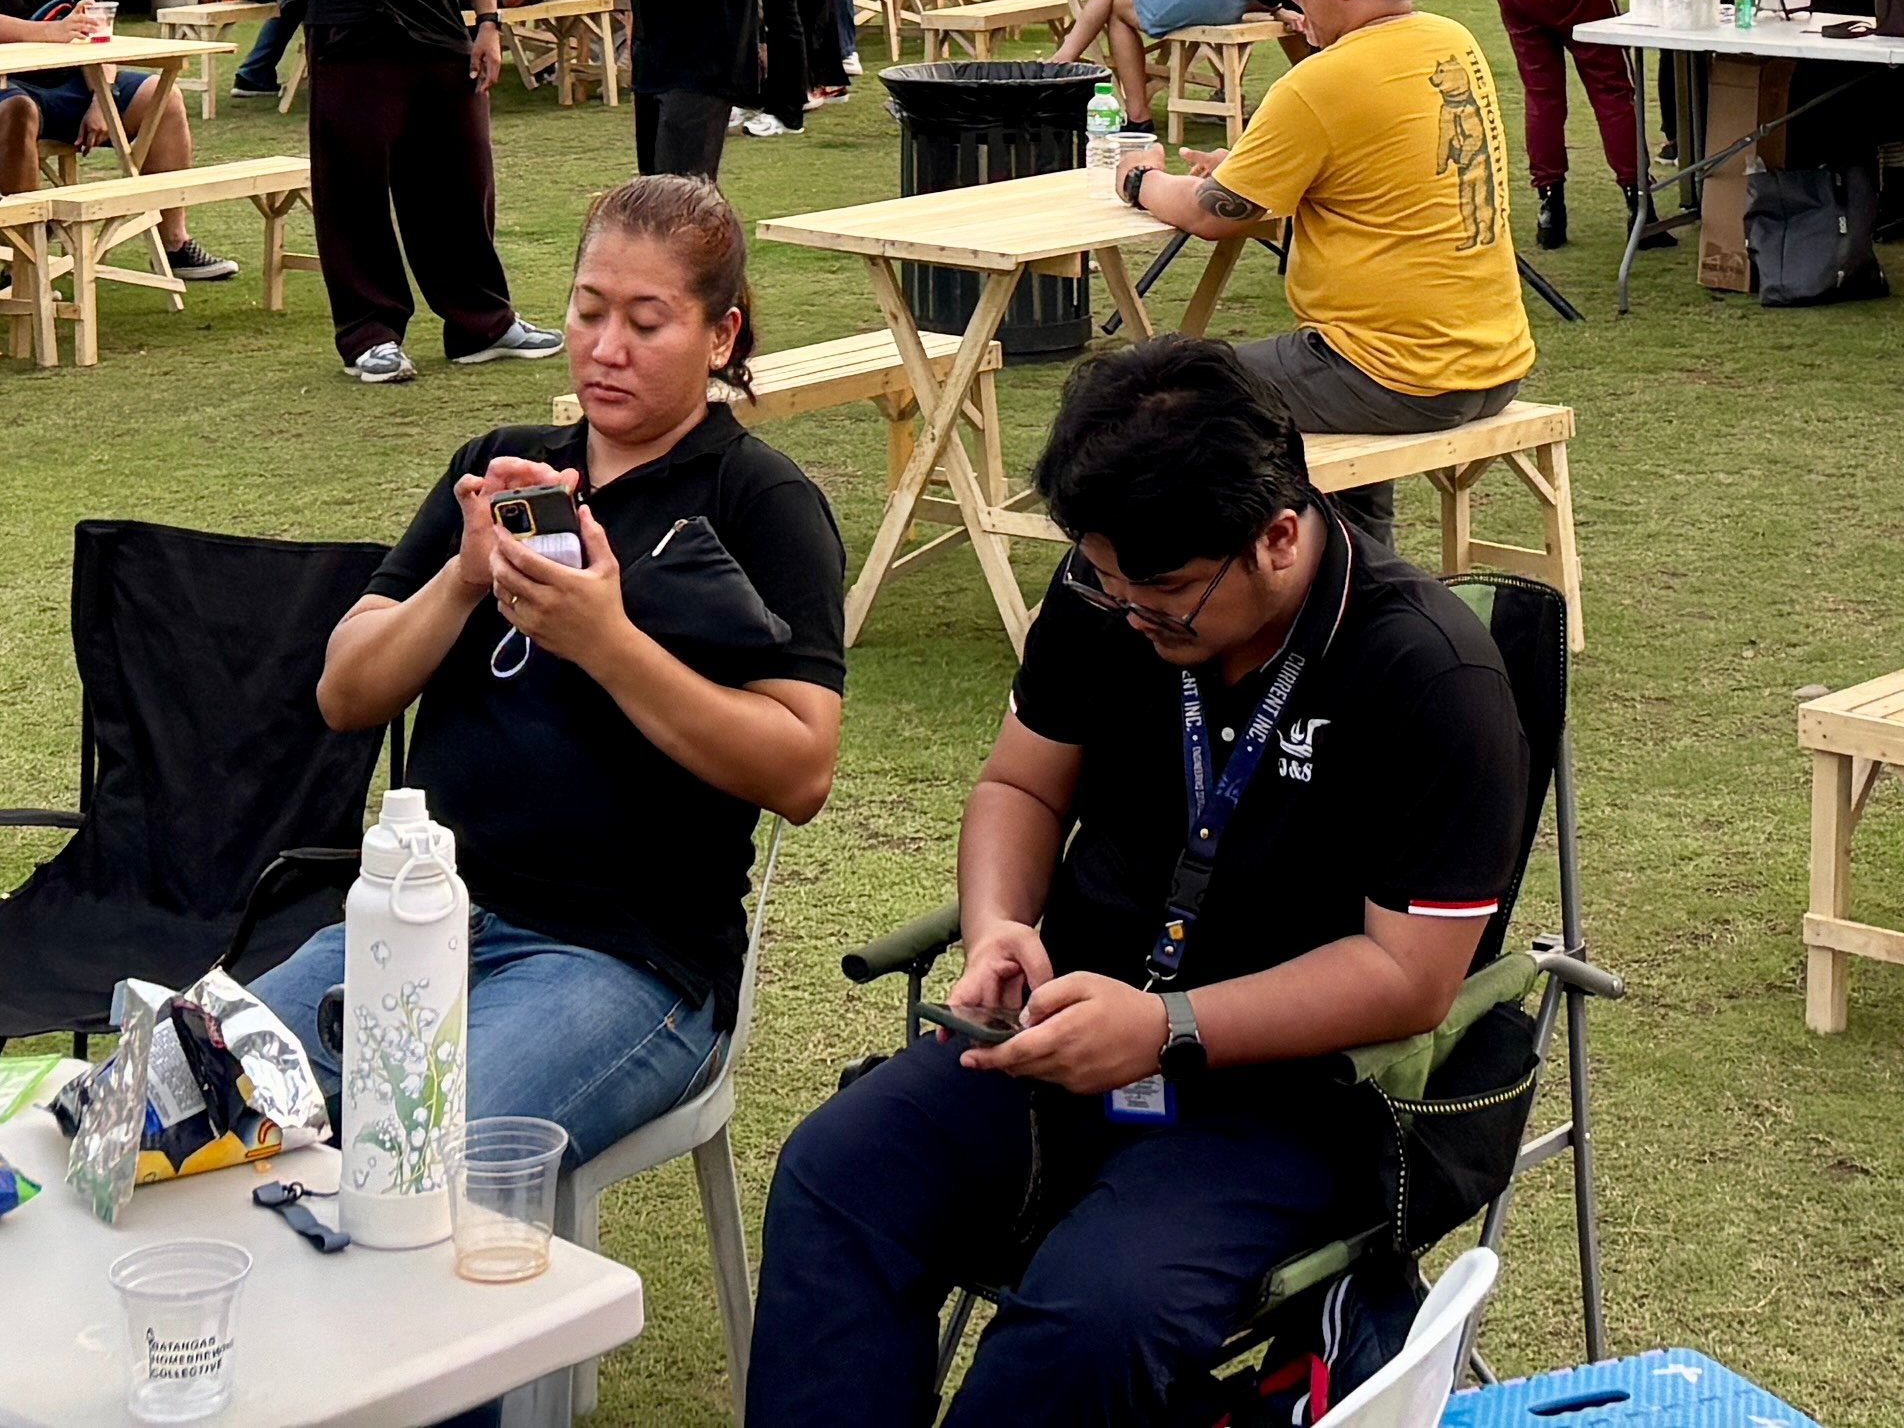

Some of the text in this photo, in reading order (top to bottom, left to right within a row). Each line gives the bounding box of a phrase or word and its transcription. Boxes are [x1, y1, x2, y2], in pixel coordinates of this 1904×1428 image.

[1466, 46, 1487, 90] THE
[1246, 652, 1306, 744] CURRENT INC.
